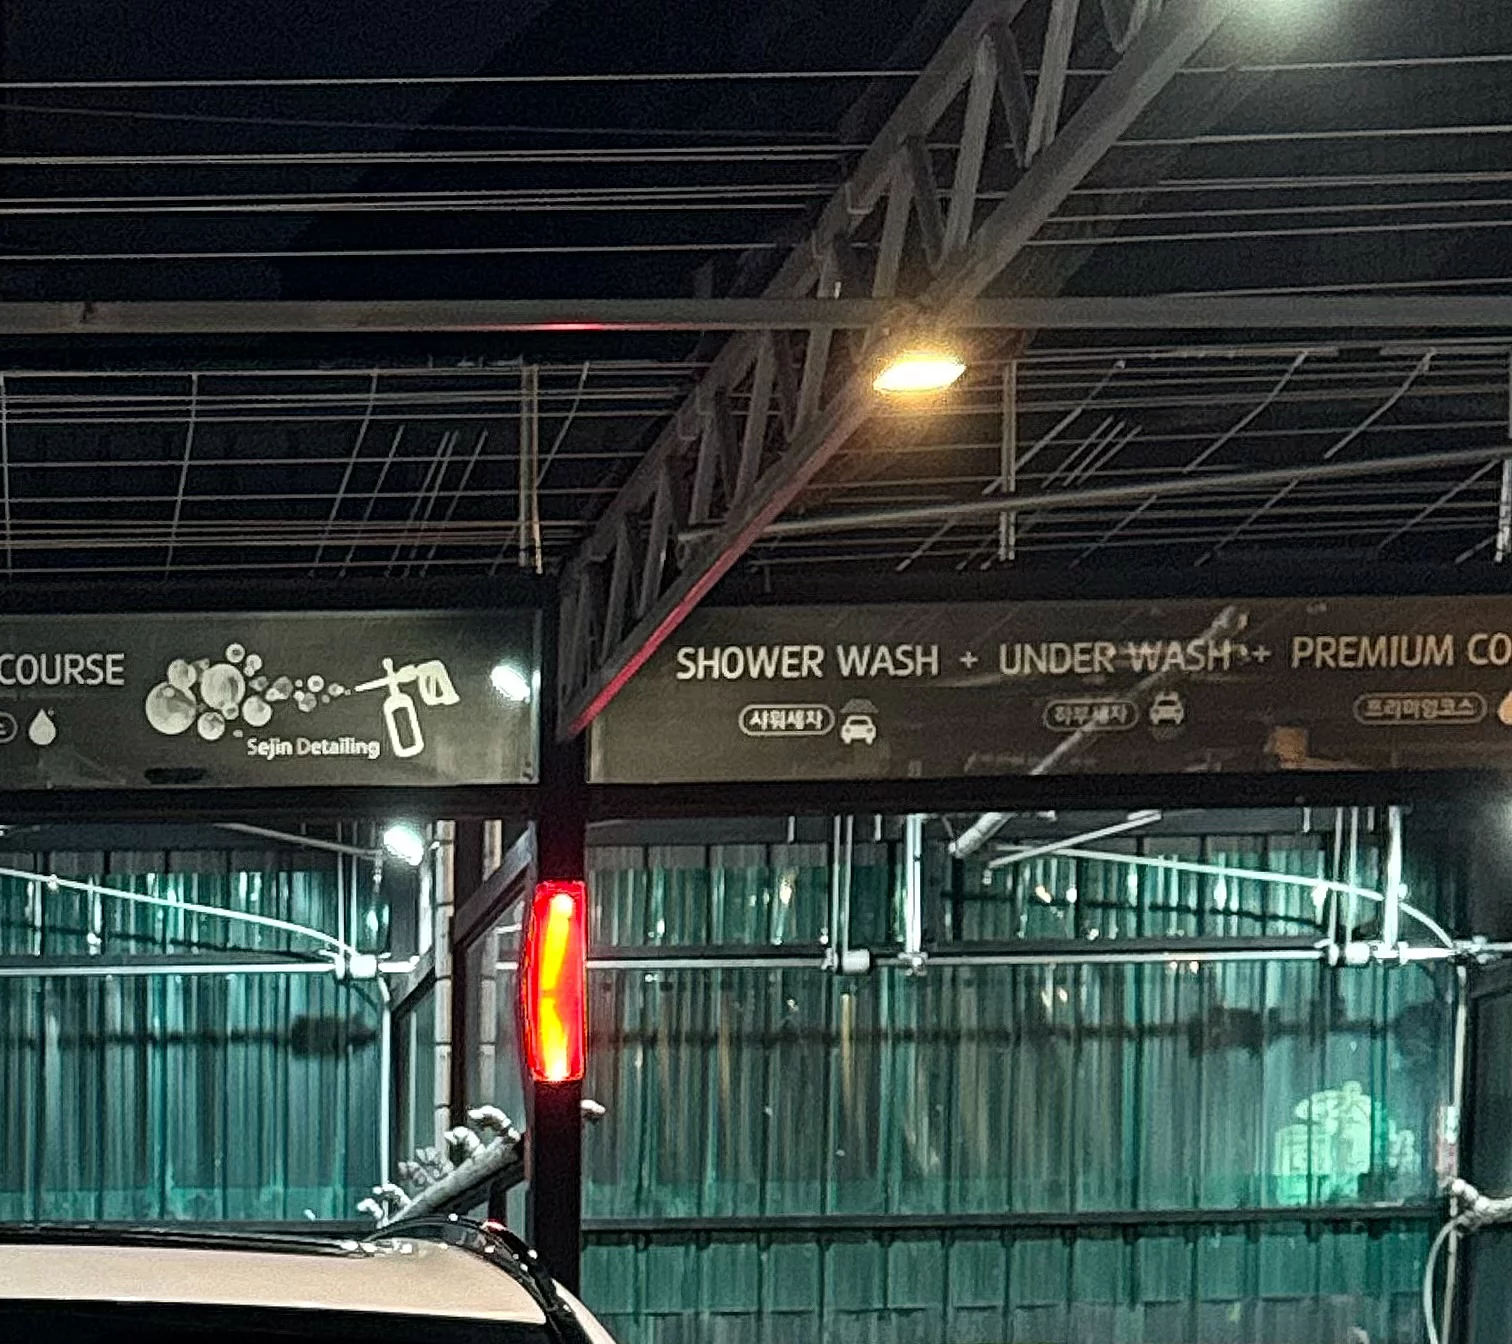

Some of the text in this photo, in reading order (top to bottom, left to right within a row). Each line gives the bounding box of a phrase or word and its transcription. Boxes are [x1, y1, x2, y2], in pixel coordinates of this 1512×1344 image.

[676, 644, 824, 679] SHOWER
[837, 643, 939, 677] WASH
[999, 641, 1116, 675] UNDER
[1128, 638, 1231, 672] WASH
[1291, 633, 1455, 669] PREMIUM
[247, 737, 381, 760] Sejin Detailing
